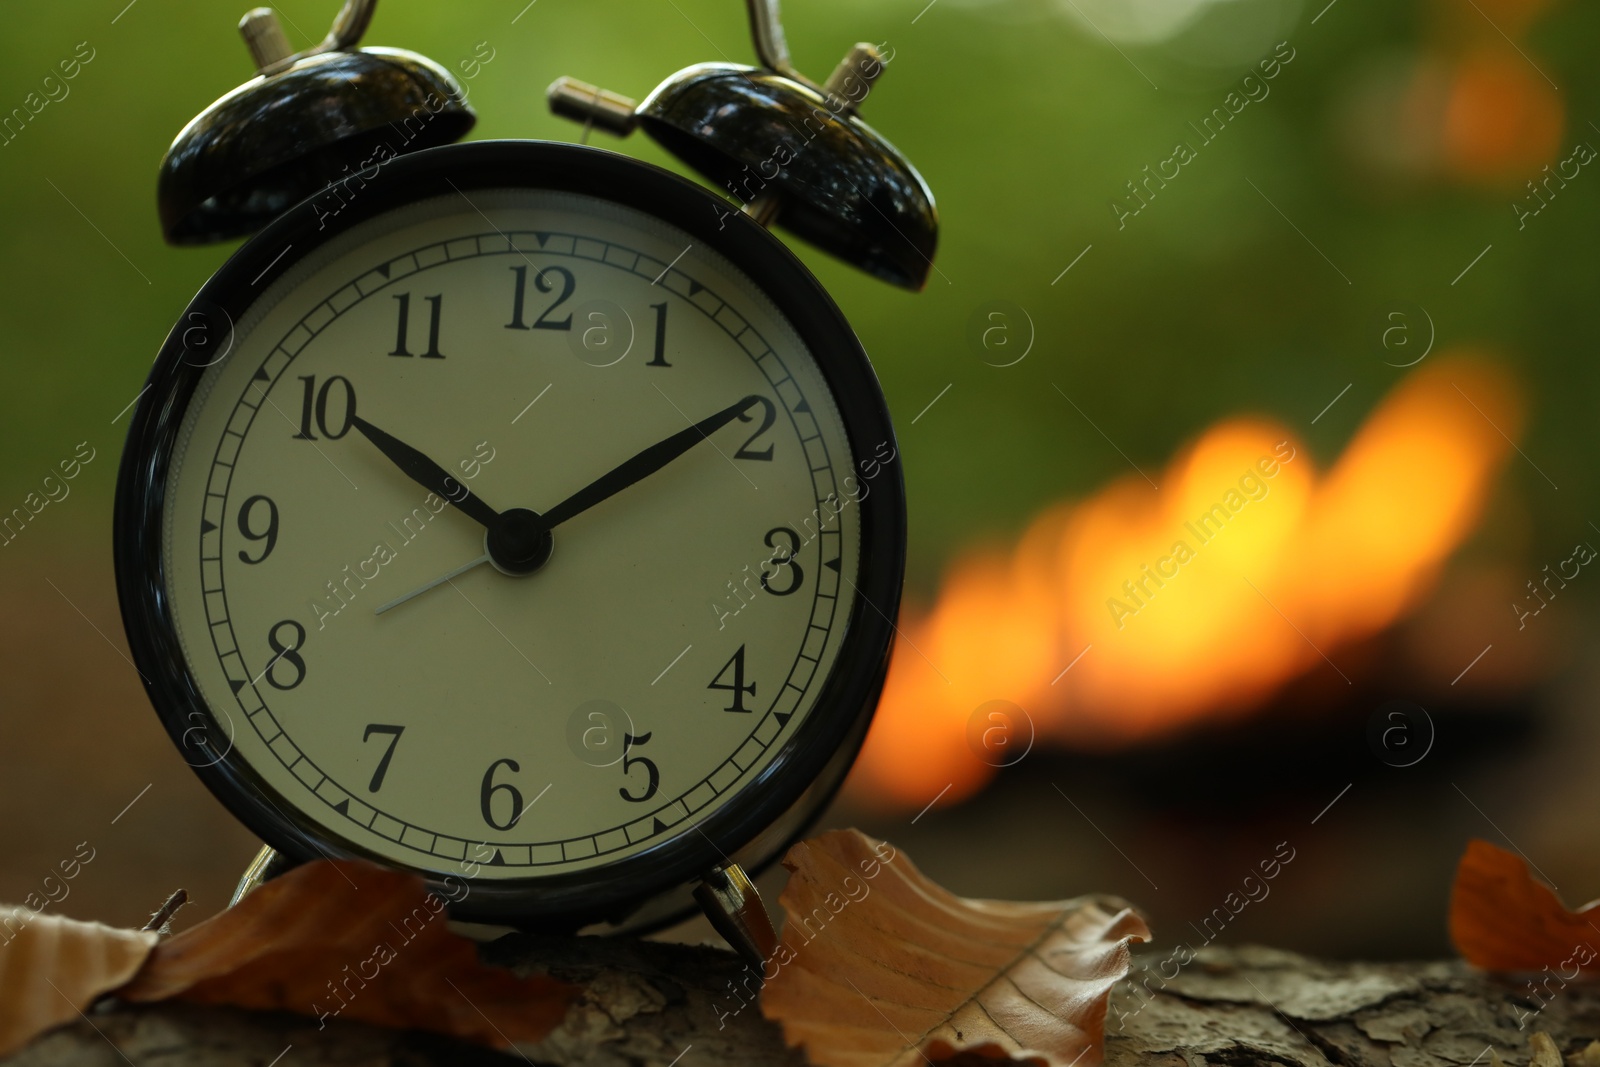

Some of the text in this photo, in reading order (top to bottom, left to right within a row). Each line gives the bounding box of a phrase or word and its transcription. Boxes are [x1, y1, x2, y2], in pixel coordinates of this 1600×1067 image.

[388, 291, 446, 361] 11
[504, 264, 576, 332] 12
[646, 301, 672, 368] 1
[292, 374, 357, 441] 10
[733, 394, 778, 462] 2
[237, 494, 280, 565] 9
[760, 526, 804, 597] 3
[264, 619, 308, 691] 8
[706, 643, 757, 714] 4
[362, 723, 406, 794] 7
[618, 731, 660, 803] 5
[480, 758, 524, 832] 6
